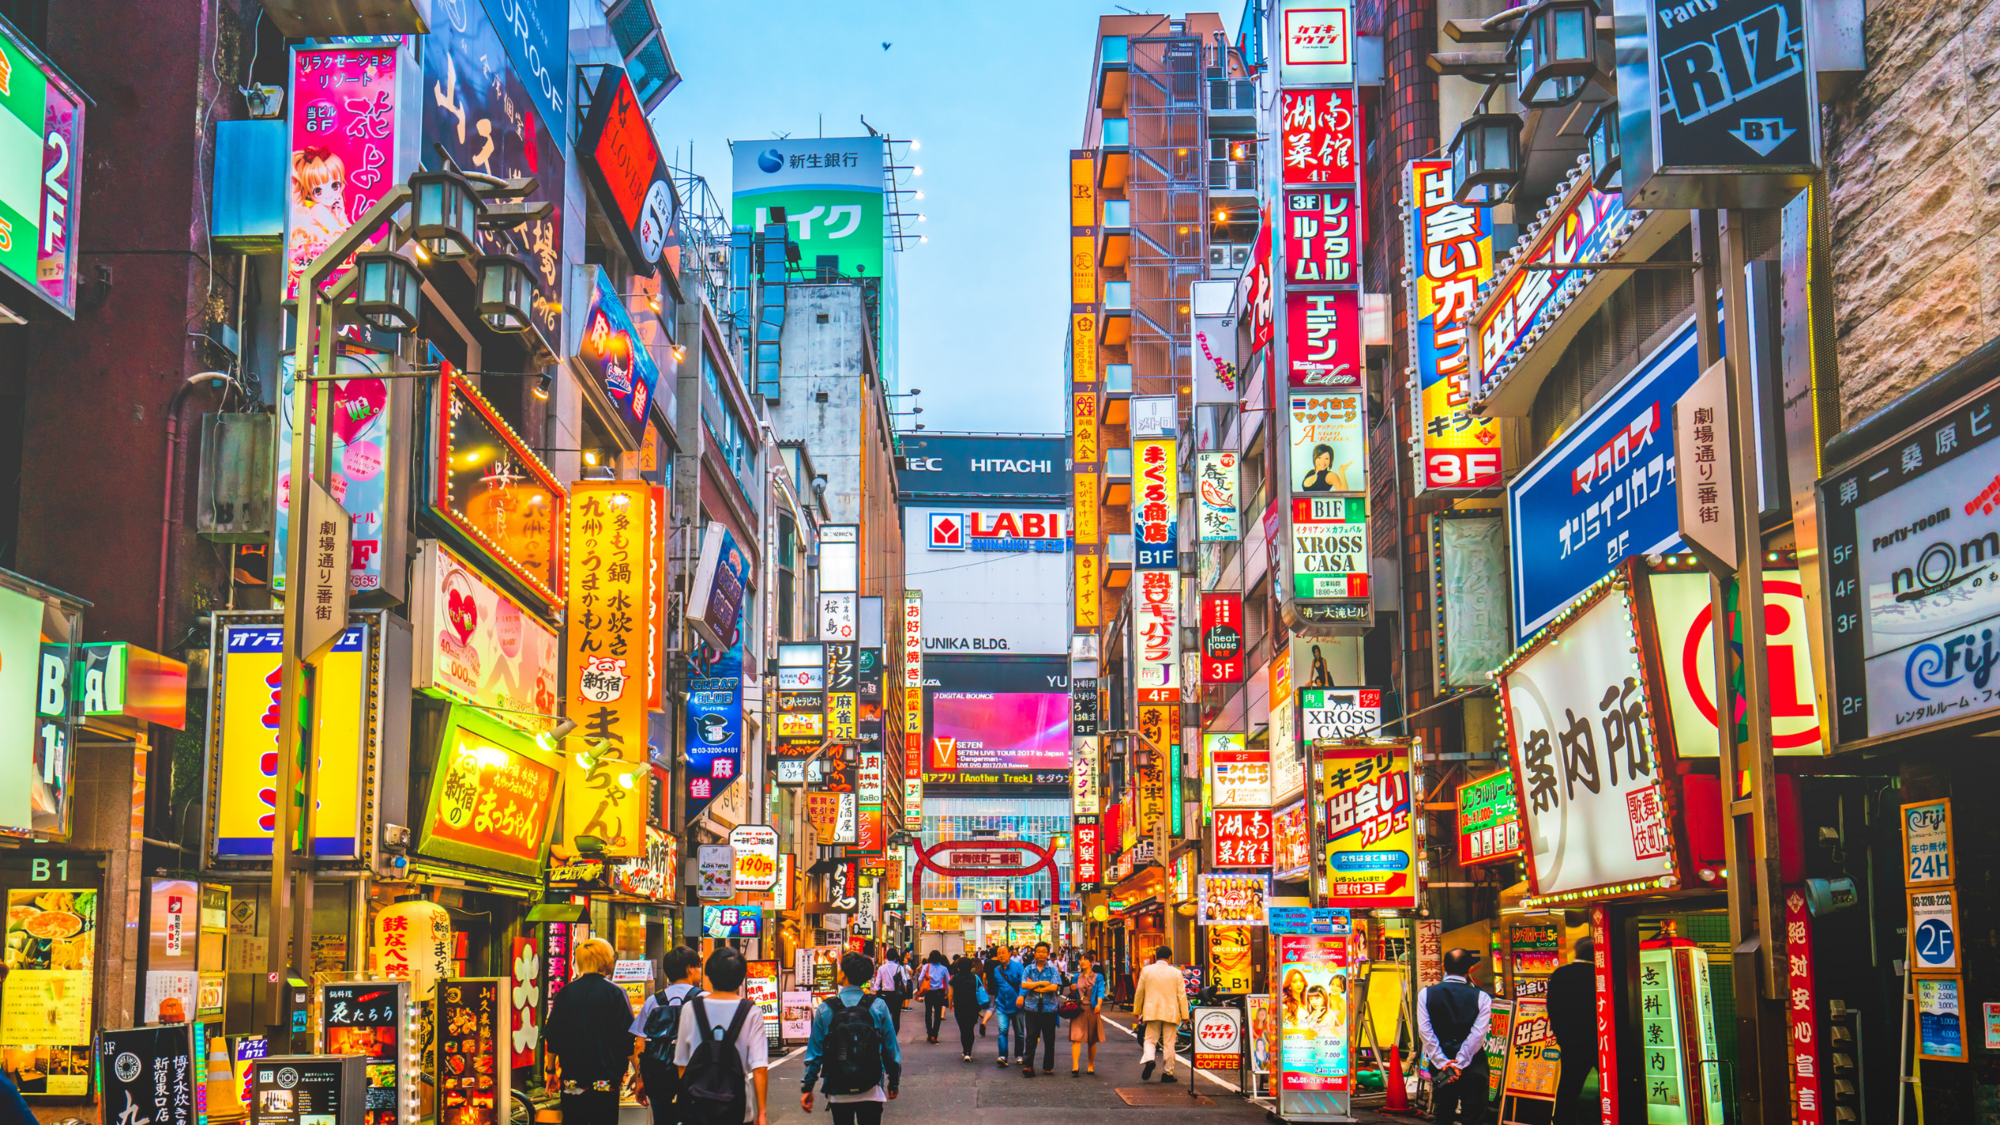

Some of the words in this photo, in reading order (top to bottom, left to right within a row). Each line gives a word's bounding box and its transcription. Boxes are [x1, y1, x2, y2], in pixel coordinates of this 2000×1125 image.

[1659, 0, 1718, 29] Party
[1298, 24, 1336, 34] カブキ
[1292, 34, 1340, 44] ラウンジ
[301, 53, 393, 70] リラクゼーション
[1661, 3, 1803, 125] RIZ
[319, 72, 372, 89] リゾート
[306, 106, 337, 119] 当ビル
[1284, 92, 1352, 132] 湖南
[306, 119, 334, 132] 6F
[1744, 120, 1781, 141] B1
[1285, 132, 1353, 169] 菜館
[604, 117, 644, 207] CLOVER
[789, 152, 858, 169] 新生銀行
[1307, 170, 1332, 182] 4F
[44, 131, 70, 254] 2F
[1073, 183, 1092, 199] R
[1292, 195, 1317, 210] 3F
[1323, 194, 1351, 281] レンタル
[1293, 216, 1320, 281] ルーム
[1306, 295, 1338, 362] エデン
[1303, 364, 1356, 386] Eden
[1308, 398, 1357, 410] タイ古式
[1293, 411, 1357, 423] マッサージ
[1076, 428, 1095, 460] 魚金
[1576, 405, 1654, 494] マクロス
[1839, 403, 1993, 506] 第一桑原ビ
[970, 459, 1052, 474] HITACHI
[1429, 453, 1497, 484] 3F
[1693, 407, 1720, 524] 劇場通り一番街
[1143, 445, 1168, 544] まぐろ商店
[1078, 480, 1091, 536] ちびすけバル
[1314, 500, 1343, 518] B1F
[1558, 452, 1676, 561] オンラインカフェ
[970, 511, 1065, 539] LABI
[1872, 507, 1951, 553] Party-room
[606, 492, 632, 585] 博多もつ鍋
[972, 539, 1030, 553] SHINJUKU
[1034, 540, 1065, 553] 東口館
[1296, 536, 1363, 554] XROSS
[1608, 530, 1630, 564] 2F
[1139, 550, 1174, 564] B1F
[1303, 554, 1356, 572] CASA
[1833, 544, 1853, 565] 5F
[316, 521, 337, 621] 劇場通り一番街
[579, 496, 605, 653] 九州のうまかもん
[1080, 570, 1096, 624] すずや
[1835, 579, 1855, 598] 4F
[606, 589, 633, 656] 水炊き
[824, 600, 839, 634] 桜島
[1140, 572, 1177, 662] 熟女キャバクラ
[1303, 607, 1368, 619] 第一大滝ビル
[1837, 613, 1857, 633] 3F
[907, 605, 920, 680] お好み焼き
[972, 638, 1011, 651] BLDG.
[1212, 627, 1241, 643] meat
[1208, 638, 1237, 657] house
[836, 645, 854, 688] リラク
[1151, 663, 1176, 686] J
[1212, 663, 1235, 679] 3F
[582, 671, 623, 701] 新宿の
[692, 678, 739, 690] GREAT
[534, 676, 556, 713] 2F
[694, 691, 733, 704] BLUE
[1148, 690, 1170, 701] 4F
[1305, 693, 1315, 703] 肉
[1360, 692, 1380, 700] イタリ
[836, 694, 853, 725] 麻雀
[1842, 697, 1863, 716] 2F
[782, 722, 813, 730] クアトロ
[1309, 710, 1376, 724] XROSS
[836, 727, 853, 739] 2F
[1077, 725, 1095, 733] 3F
[1317, 725, 1369, 740] CASA
[956, 741, 983, 749] SE7EN
[1044, 750, 1064, 758] Japan
[1523, 676, 1654, 817] 案内所
[584, 707, 627, 846] まっちゃん
[908, 768, 918, 776] 4F
[1076, 757, 1089, 799] バンタイ
[1229, 764, 1269, 774] タイ古式
[1331, 750, 1394, 789] キラリ
[1217, 774, 1269, 785] マッサージ
[444, 768, 478, 824] 新宿の
[810, 796, 837, 806] 悪質な
[1462, 775, 1515, 811] レンタルルーム
[810, 806, 836, 815] 客引き
[840, 793, 854, 832] 居酒屋
[1329, 773, 1405, 836] 出会い
[474, 788, 540, 850] まっちゃん
[1078, 816, 1096, 825] 焼肉
[1217, 811, 1270, 839] 湖南
[1361, 810, 1409, 846] カフェ
[858, 811, 872, 849] ステップ
[733, 837, 775, 845] 一軒め酒場
[1910, 841, 1948, 855] 年中無休
[952, 853, 1020, 864] 歌舞伎町一番街
[1079, 828, 1096, 879] 安楽亭
[1218, 840, 1258, 864] 菜館
[1258, 840, 1270, 864] 4F
[1340, 853, 1399, 863] 女性は全て無料!
[32, 858, 68, 882] B1
[740, 857, 773, 873] 190円
[1910, 853, 1950, 880] 24H
[1080, 883, 1094, 891] 2F
[1336, 883, 1386, 894] 受付3F
[995, 900, 1040, 913] LABI
[174, 914, 182, 951] 防犯カメラ
[1512, 926, 1548, 943] レンタルルーム
[1547, 929, 1558, 941] 5F
[1920, 924, 1952, 956] 2F
[747, 985, 764, 995] 焼肉
[1232, 978, 1250, 989] B1
[1516, 981, 1548, 997] 出会い
[329, 990, 353, 999] 鍋料理
[328, 1001, 394, 1023] 花たろう
[479, 986, 491, 1040] 山久農場
[1204, 1023, 1233, 1031] カブキ
[1491, 1013, 1510, 1038] OPEN
[1641, 966, 1669, 1103] 無料案内所
[1201, 1031, 1235, 1040] ラウンジ
[245, 1048, 265, 1058] カフェ
[1514, 1045, 1542, 1060] キラリ
[1196, 1059, 1239, 1069] COFFEE
[260, 1072, 274, 1081] 6F
[153, 1056, 170, 1122] 新宿東口店
